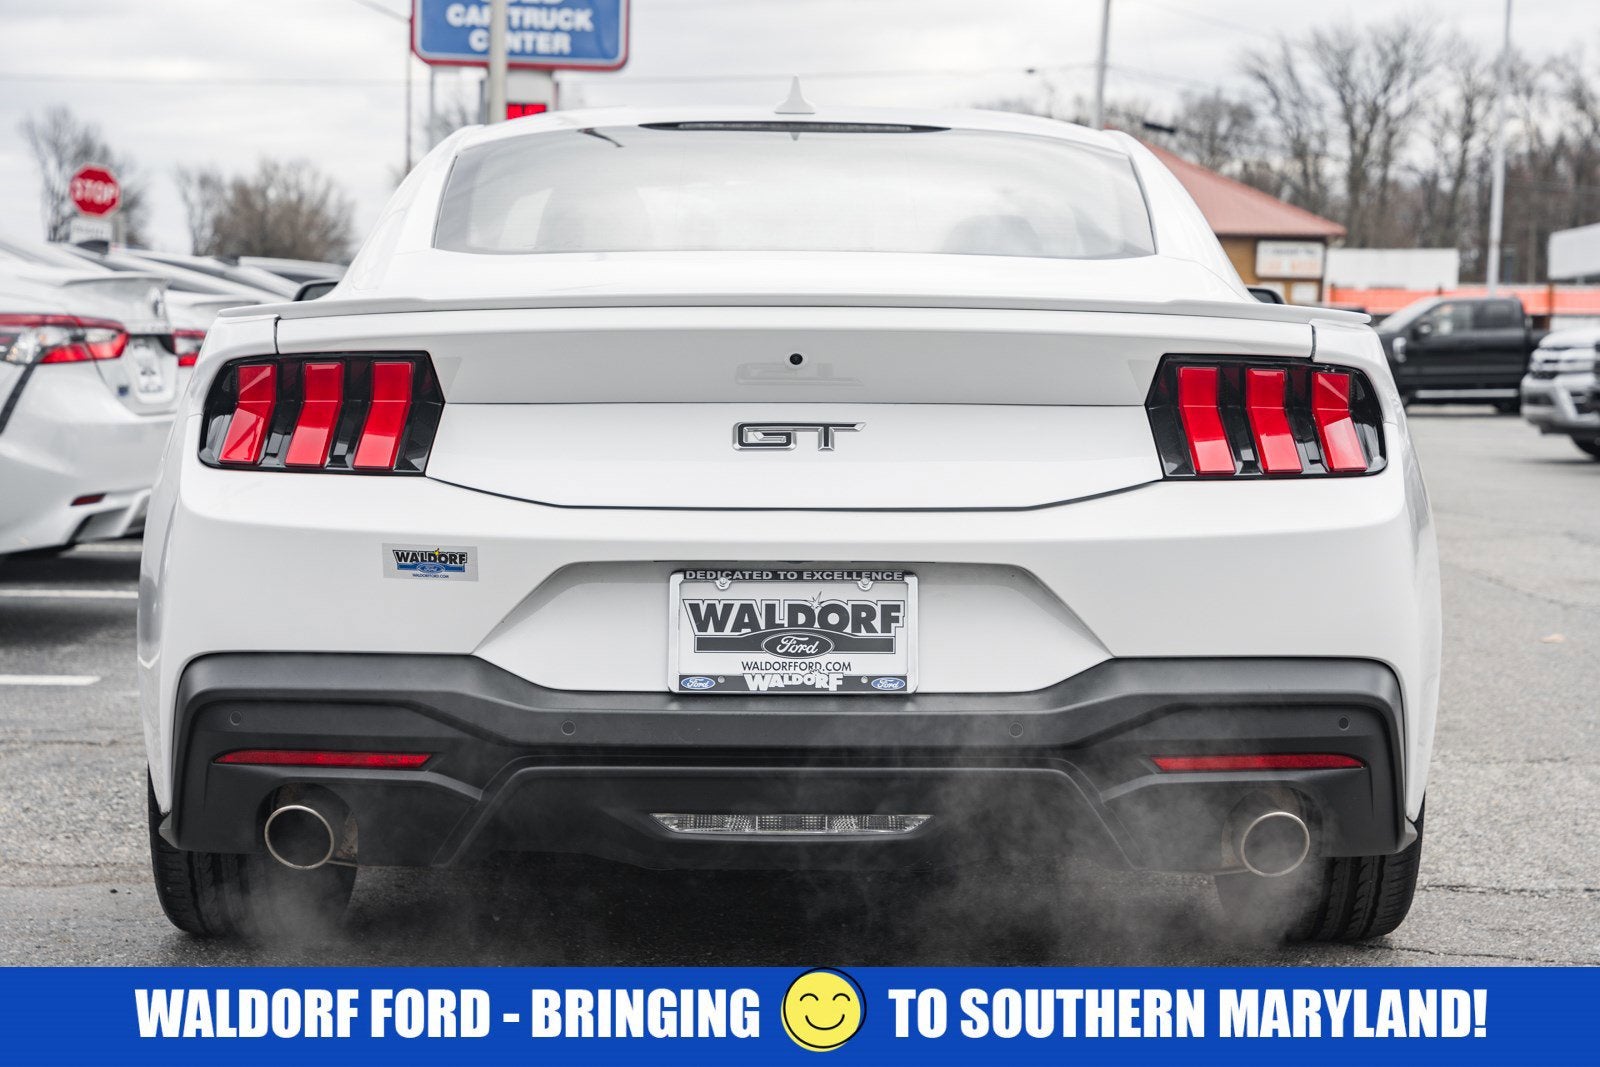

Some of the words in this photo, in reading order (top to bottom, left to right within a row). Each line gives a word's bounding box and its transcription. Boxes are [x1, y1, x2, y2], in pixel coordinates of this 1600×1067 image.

[508, 7, 594, 32] TRUCK
[469, 29, 571, 54] CNTER
[74, 179, 116, 204] STOP
[733, 422, 866, 451] GT
[393, 550, 467, 564] WALDORF
[685, 570, 772, 581] DEDICATED
[777, 571, 798, 580] TO
[803, 571, 903, 581] EXCELLENCE
[685, 600, 904, 635] WALDORF
[776, 636, 819, 655] Ford
[741, 661, 852, 672] WALDORFFORD.COM
[686, 677, 710, 688] Ford
[743, 672, 844, 691] WALDORF
[876, 679, 901, 689] Ford
